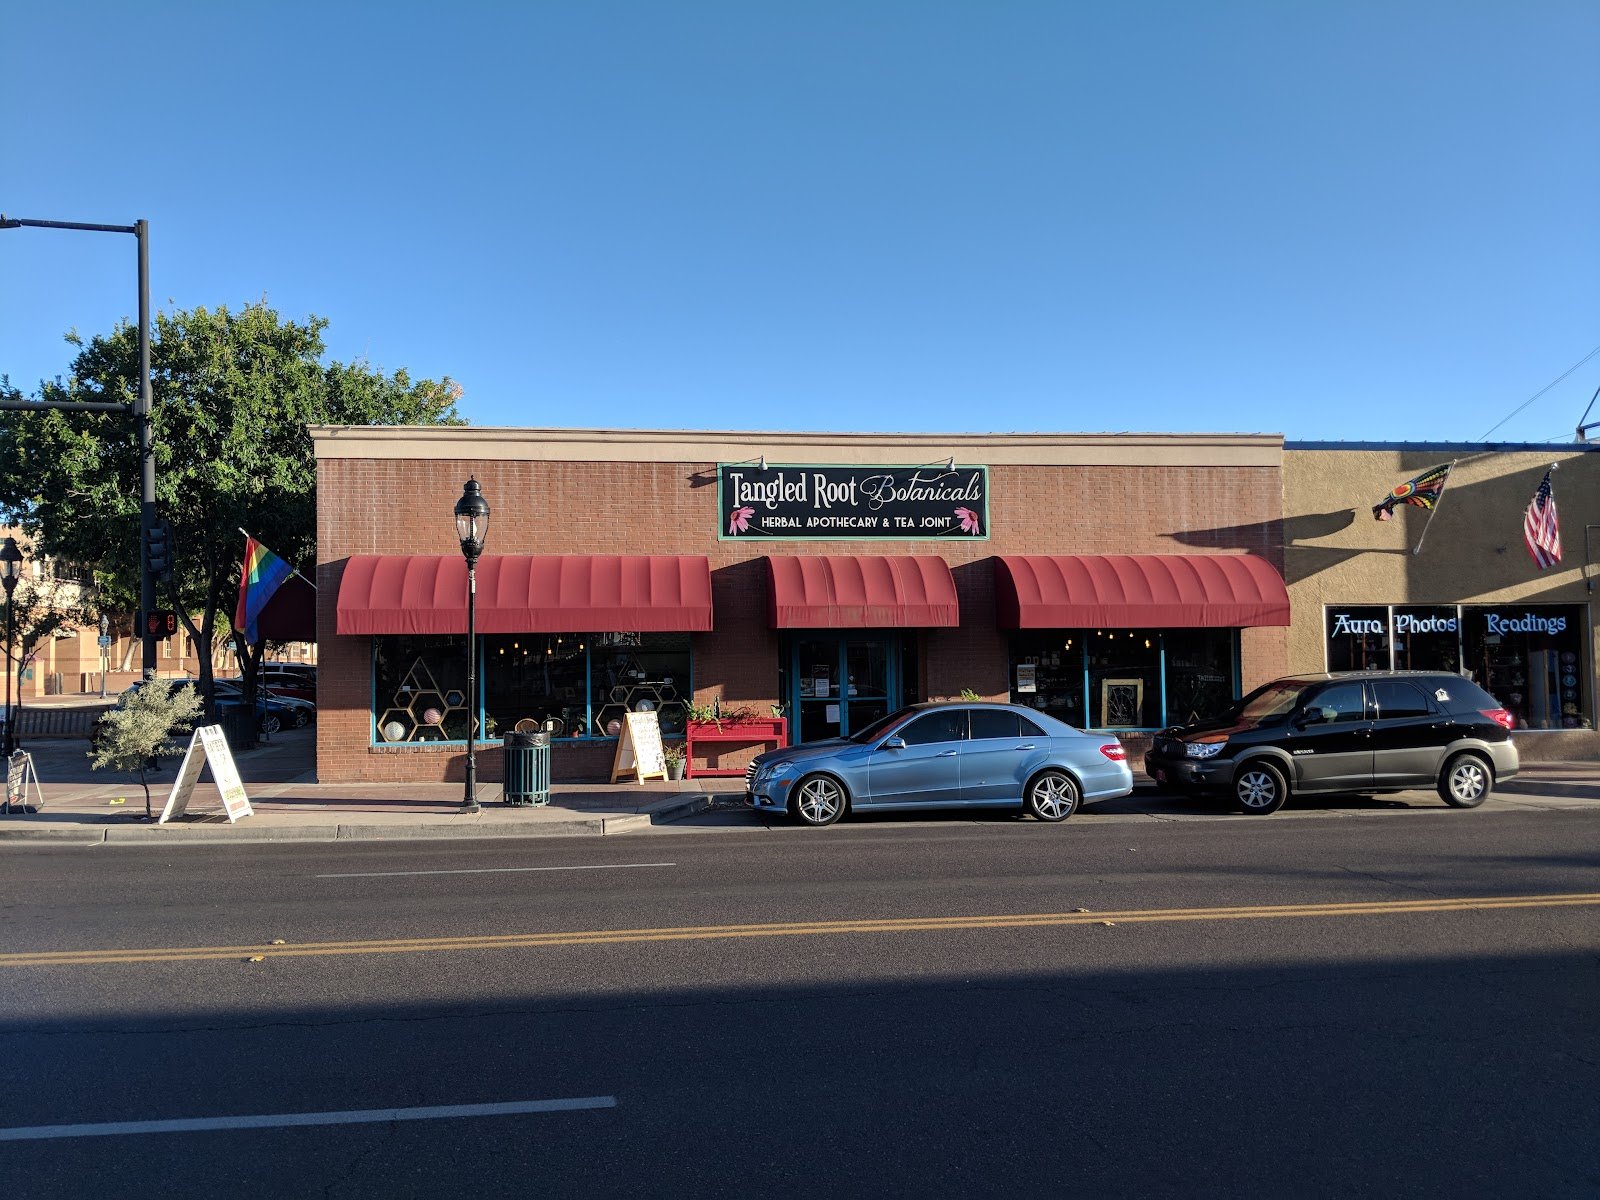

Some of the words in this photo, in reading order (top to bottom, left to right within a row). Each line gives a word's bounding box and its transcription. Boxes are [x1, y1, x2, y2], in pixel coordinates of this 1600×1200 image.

[730, 473, 807, 509] Tangled
[813, 474, 858, 508] Root
[860, 471, 981, 510] Botanicals
[762, 517, 802, 527] HERBAL
[807, 517, 878, 527] APOTHECARY
[883, 517, 890, 527] &
[894, 517, 915, 527] TEA
[919, 517, 951, 527] JOINT
[1332, 614, 1383, 638] Aura
[1394, 614, 1457, 634] Photos
[1484, 613, 1567, 636] Readings
